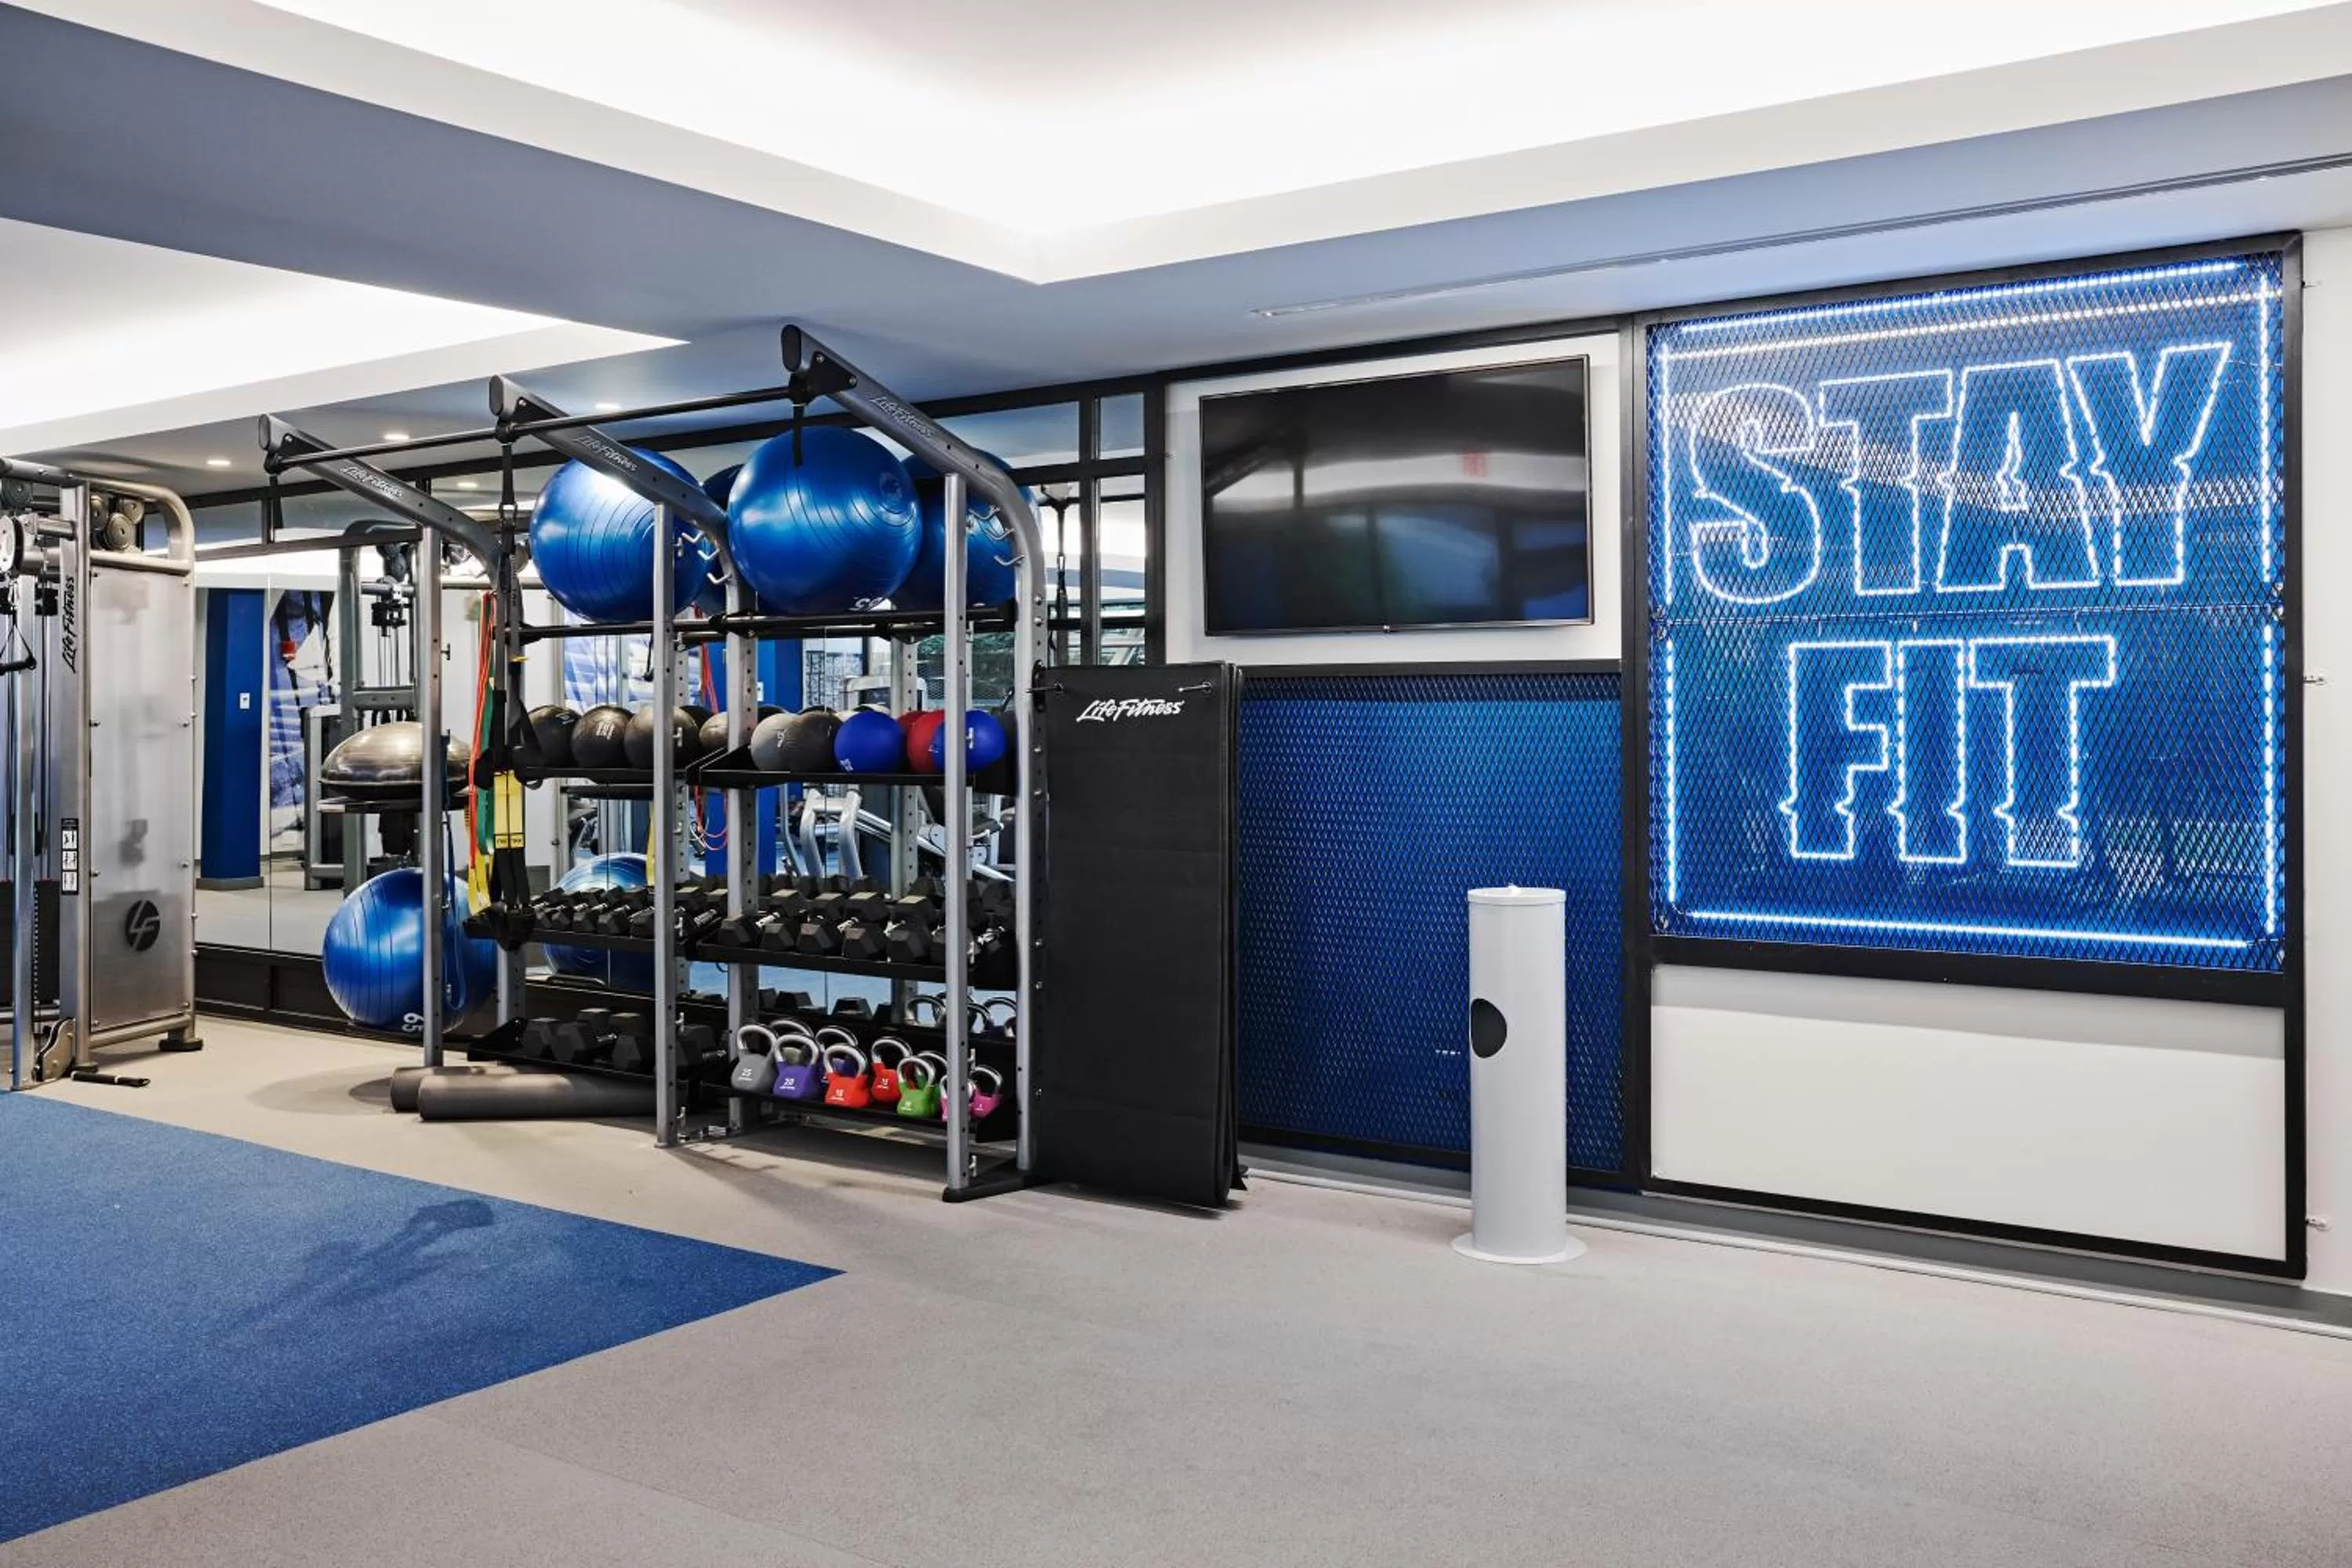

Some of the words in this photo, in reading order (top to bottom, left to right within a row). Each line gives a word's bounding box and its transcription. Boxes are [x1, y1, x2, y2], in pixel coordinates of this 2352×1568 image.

[1689, 342, 2233, 604] STAY
[1780, 636, 2115, 869] FIT
[401, 1012, 424, 1033] 65
